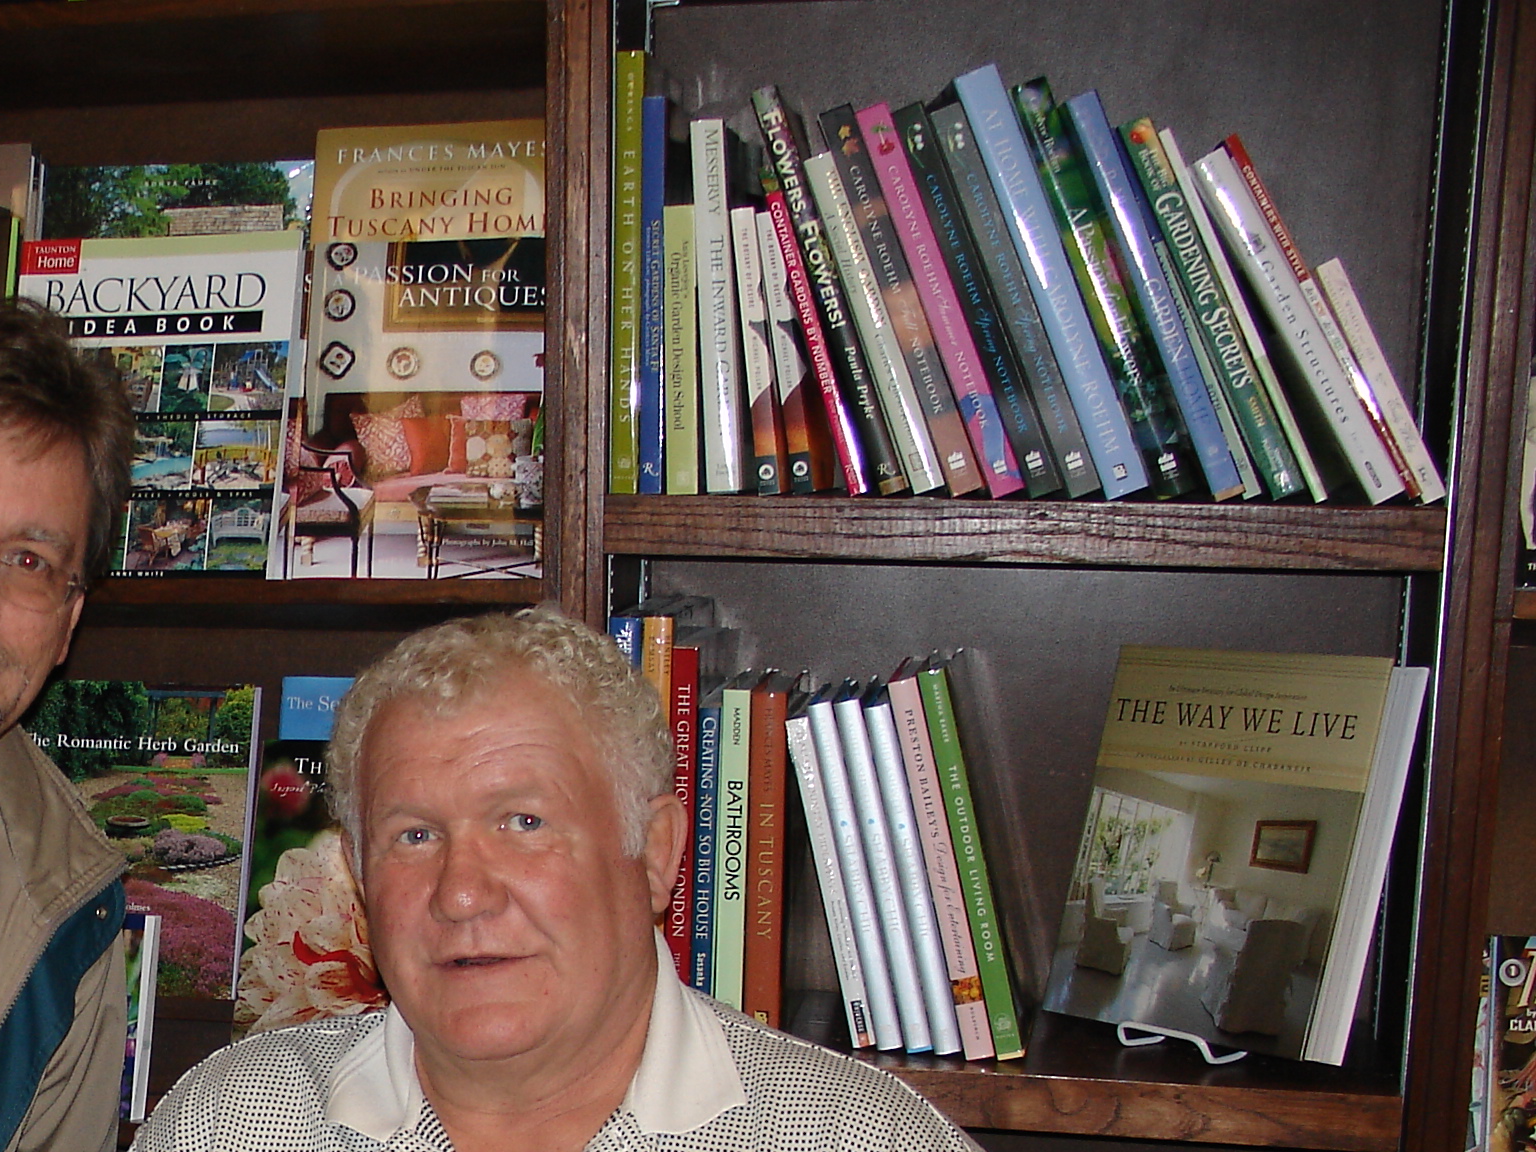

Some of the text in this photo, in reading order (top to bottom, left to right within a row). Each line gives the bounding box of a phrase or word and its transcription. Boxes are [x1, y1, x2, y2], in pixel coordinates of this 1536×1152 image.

[337, 144, 454, 164] FRANCES
[370, 187, 513, 210] BRINGING
[35, 246, 76, 254] TAUNTON
[38, 255, 75, 268] Home
[328, 215, 454, 237] TUSCANY
[355, 263, 520, 285] PASSION FOR
[705, 128, 727, 352] MESSERVY THE INWARD
[45, 272, 267, 314] BACKYARD
[68, 315, 235, 335] IDEA BOOK
[620, 151, 636, 423] EARTH ON HER HANDS
[771, 202, 833, 395] CONTAINER GARDENS BY NUMBER
[849, 165, 942, 416] CAROLYNE ROEHM NOTEBOOK
[888, 165, 988, 430] CAROLYNE ROEHM NOTEBOOK
[926, 174, 961, 249] CAROLYNE
[955, 253, 981, 306] ROEHM
[993, 355, 1028, 435] NOTEBOOK
[966, 173, 1067, 435] CAROLYNE ROEHM NOTEBOOK
[1143, 278, 1188, 365] GARDEN
[1154, 192, 1254, 390] GARDENING SECRETS
[670, 252, 686, 431] Organic Garden Design School
[844, 346, 875, 420] Paula Pryke
[1260, 259, 1350, 426] Garden Structures
[57, 733, 132, 750] Romantic
[138, 735, 177, 752] Herb
[183, 738, 239, 754] Garden
[287, 696, 313, 710] The
[675, 684, 691, 773] THE GREAT
[732, 707, 741, 745] MADDEN
[1117, 699, 1358, 740] THE WAY WE LIVE
[695, 717, 717, 939] CREATING NOT SO BIG HOUSE
[724, 781, 744, 901] BATHROOMS
[903, 708, 925, 772] PRESTON
[918, 776, 940, 839] BAILEY'S
[929, 840, 953, 884] Design
[756, 804, 775, 940] IN TUSCANY
[947, 764, 995, 963] THE OUTDOOR LIVING ROOM
